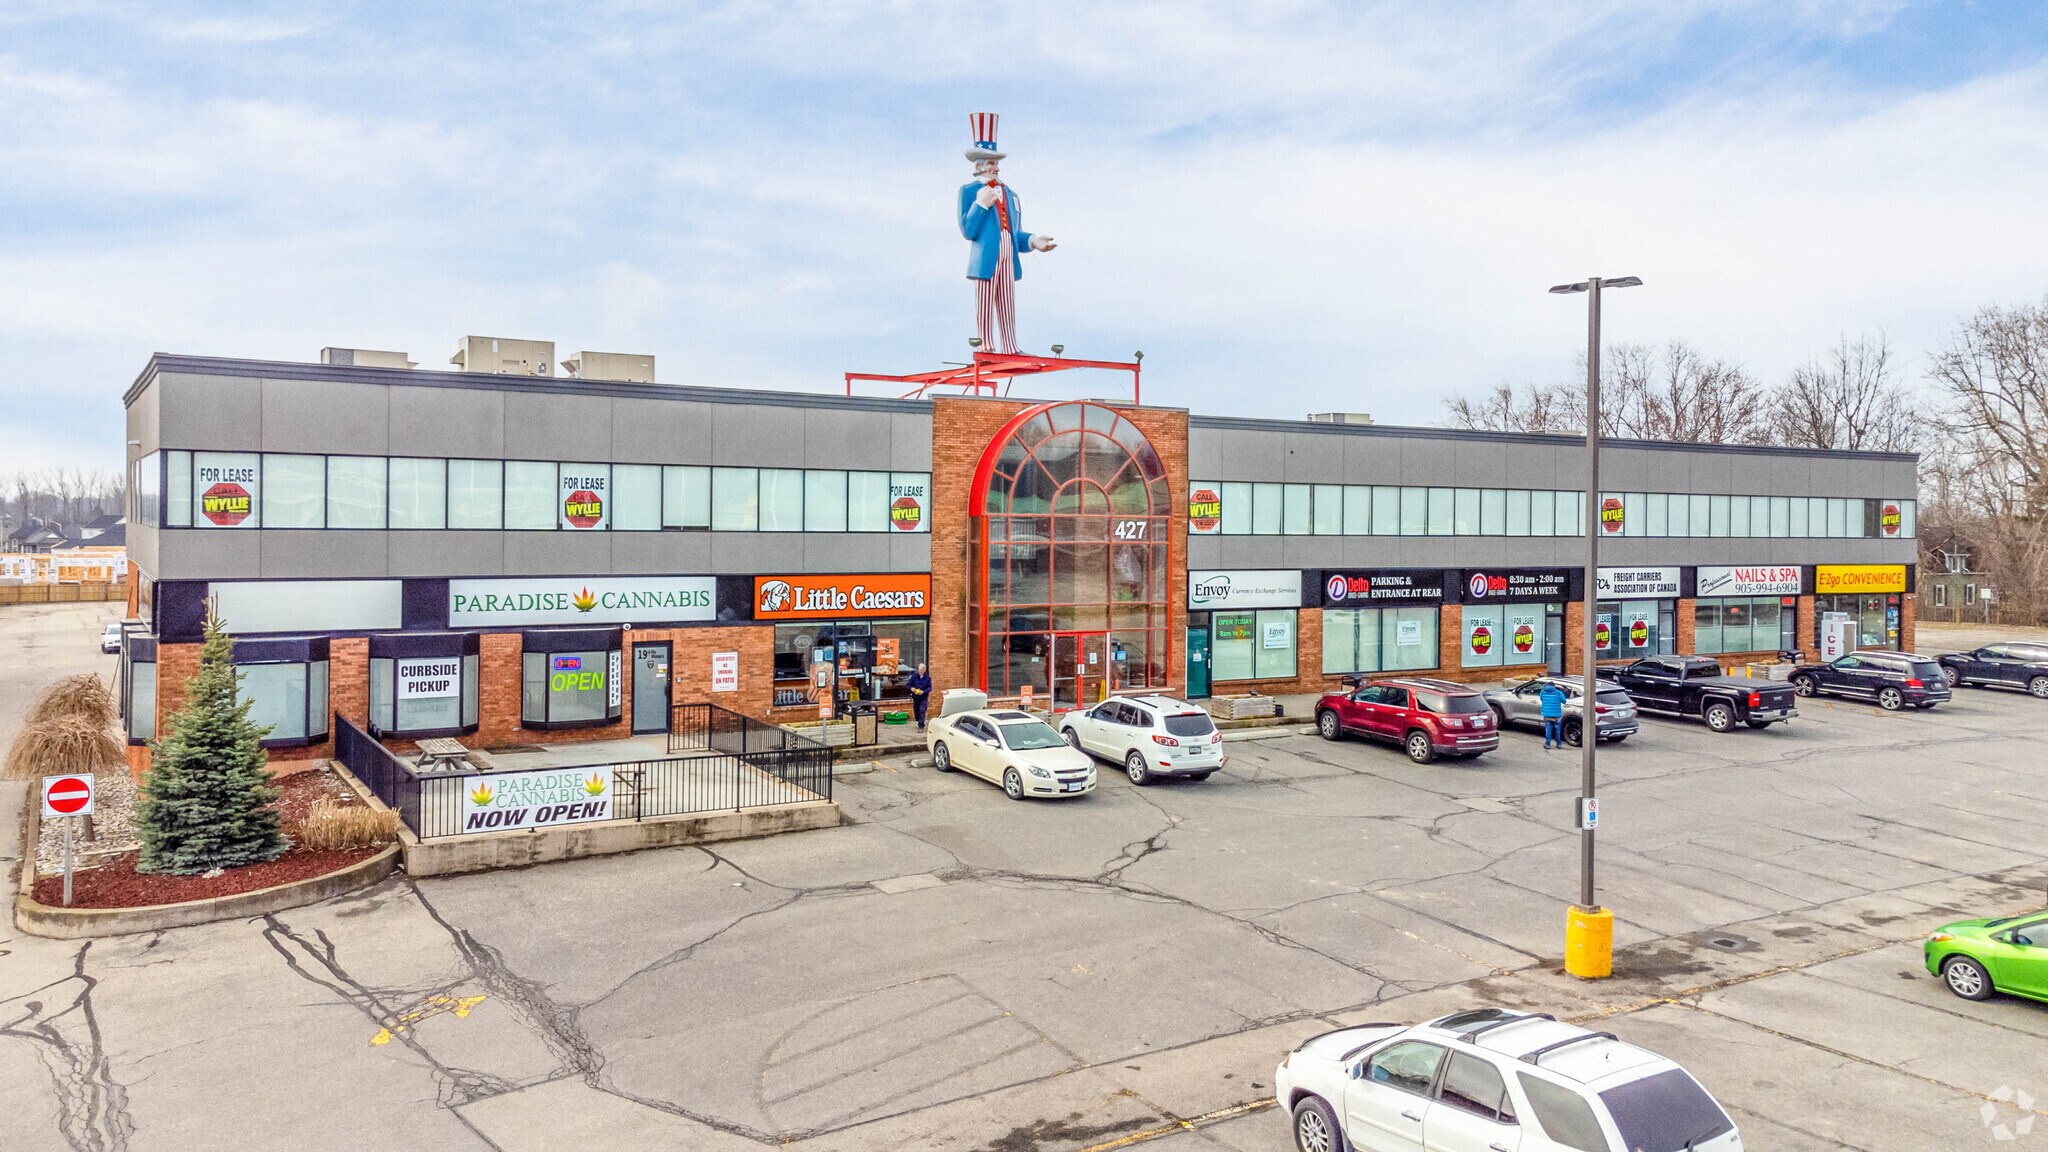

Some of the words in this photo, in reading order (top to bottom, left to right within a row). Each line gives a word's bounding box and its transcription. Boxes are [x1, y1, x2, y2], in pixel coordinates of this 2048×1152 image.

[200, 467, 220, 481] FOR
[222, 468, 254, 482] LEASE
[563, 477, 579, 490] FOR
[580, 477, 605, 490] LEASE
[890, 486, 903, 496] FOR
[903, 486, 924, 497] LEASE
[1196, 493, 1213, 501] CALL
[204, 497, 249, 512] WYLLIE
[566, 503, 601, 516] WYLLIE
[1190, 503, 1220, 517] WYLLIE
[892, 508, 919, 520] WYLLIE
[1114, 520, 1147, 539] 427
[1371, 576, 1404, 586] PARKING
[1405, 576, 1412, 586] &
[1509, 575, 1524, 584] 8:30
[1539, 575, 1554, 584] 2:00
[1613, 572, 1636, 582] FREIGHT
[1636, 572, 1662, 581] CARRIERS
[1700, 569, 1731, 592] Professional
[1735, 568, 1767, 583] NAILS
[1769, 568, 1777, 582] &
[1779, 568, 1798, 582] SPA
[1842, 572, 1902, 585] CONVENIENCE
[1194, 583, 1231, 600] Envoy
[1232, 587, 1254, 595] Currency
[1277, 586, 1297, 594] Services
[1371, 588, 1410, 599] ENTRANCE
[1410, 588, 1421, 598] AT
[1422, 588, 1442, 597] REAR
[1509, 587, 1514, 595] 7
[1515, 587, 1533, 595] DAYS
[1533, 587, 1539, 595] A
[1539, 586, 1558, 595] WEEK
[1613, 584, 1648, 594] ASSOCIATION
[1649, 583, 1656, 593] OF
[1656, 583, 1677, 593] CANADA
[1734, 583, 1798, 594] 905-994-6904
[453, 592, 569, 613] PARADISE
[601, 589, 711, 610] CANNABIS
[793, 586, 848, 611] Little
[850, 585, 925, 610] Caesars
[1470, 618, 1479, 627] FOR
[1479, 618, 1492, 627] LEASE
[1513, 617, 1522, 625] FOR
[1523, 616, 1534, 625] LEASE
[1600, 614, 1611, 623] LEASE
[1630, 613, 1638, 621] FOR
[1638, 612, 1649, 620] LEASE
[1827, 623, 1836, 656] ICE
[401, 664, 457, 677] CURBSIDE
[408, 680, 450, 693] PICKUP
[551, 672, 605, 692] OPEN
[498, 774, 584, 794] PARADISE
[496, 787, 586, 809] CANNABIS
[466, 808, 529, 830] NOW
[535, 800, 608, 823] OPEN!
